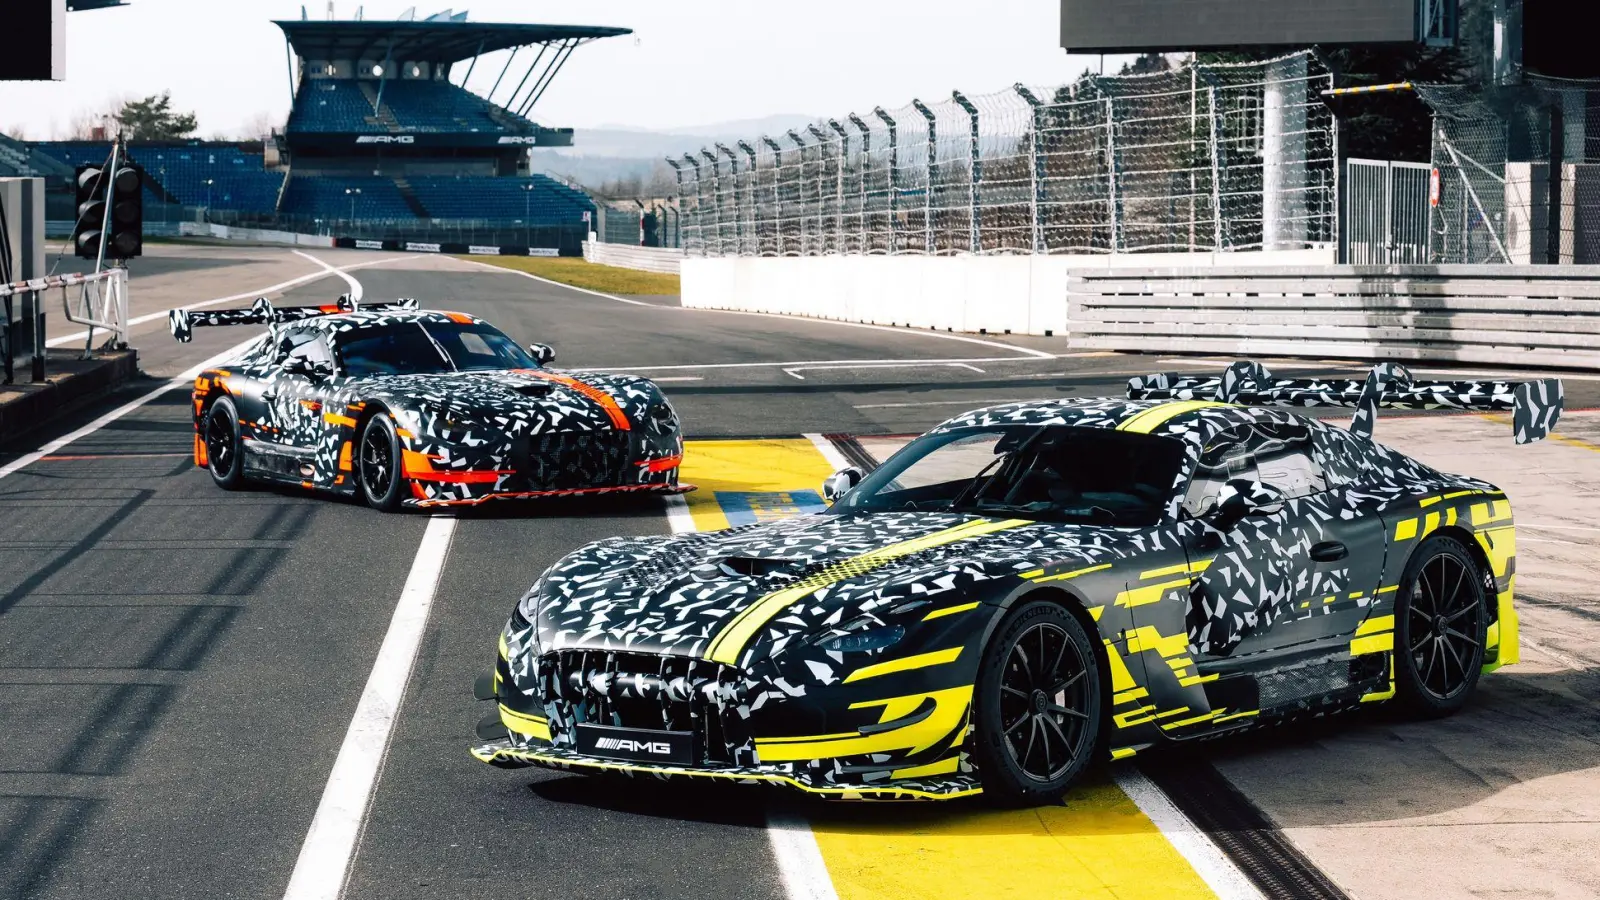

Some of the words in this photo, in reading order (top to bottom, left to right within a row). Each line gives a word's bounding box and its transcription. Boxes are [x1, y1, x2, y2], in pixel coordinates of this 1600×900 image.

[374, 135, 414, 143] AMG
[511, 136, 536, 144] AMG
[616, 740, 671, 754] AMG
